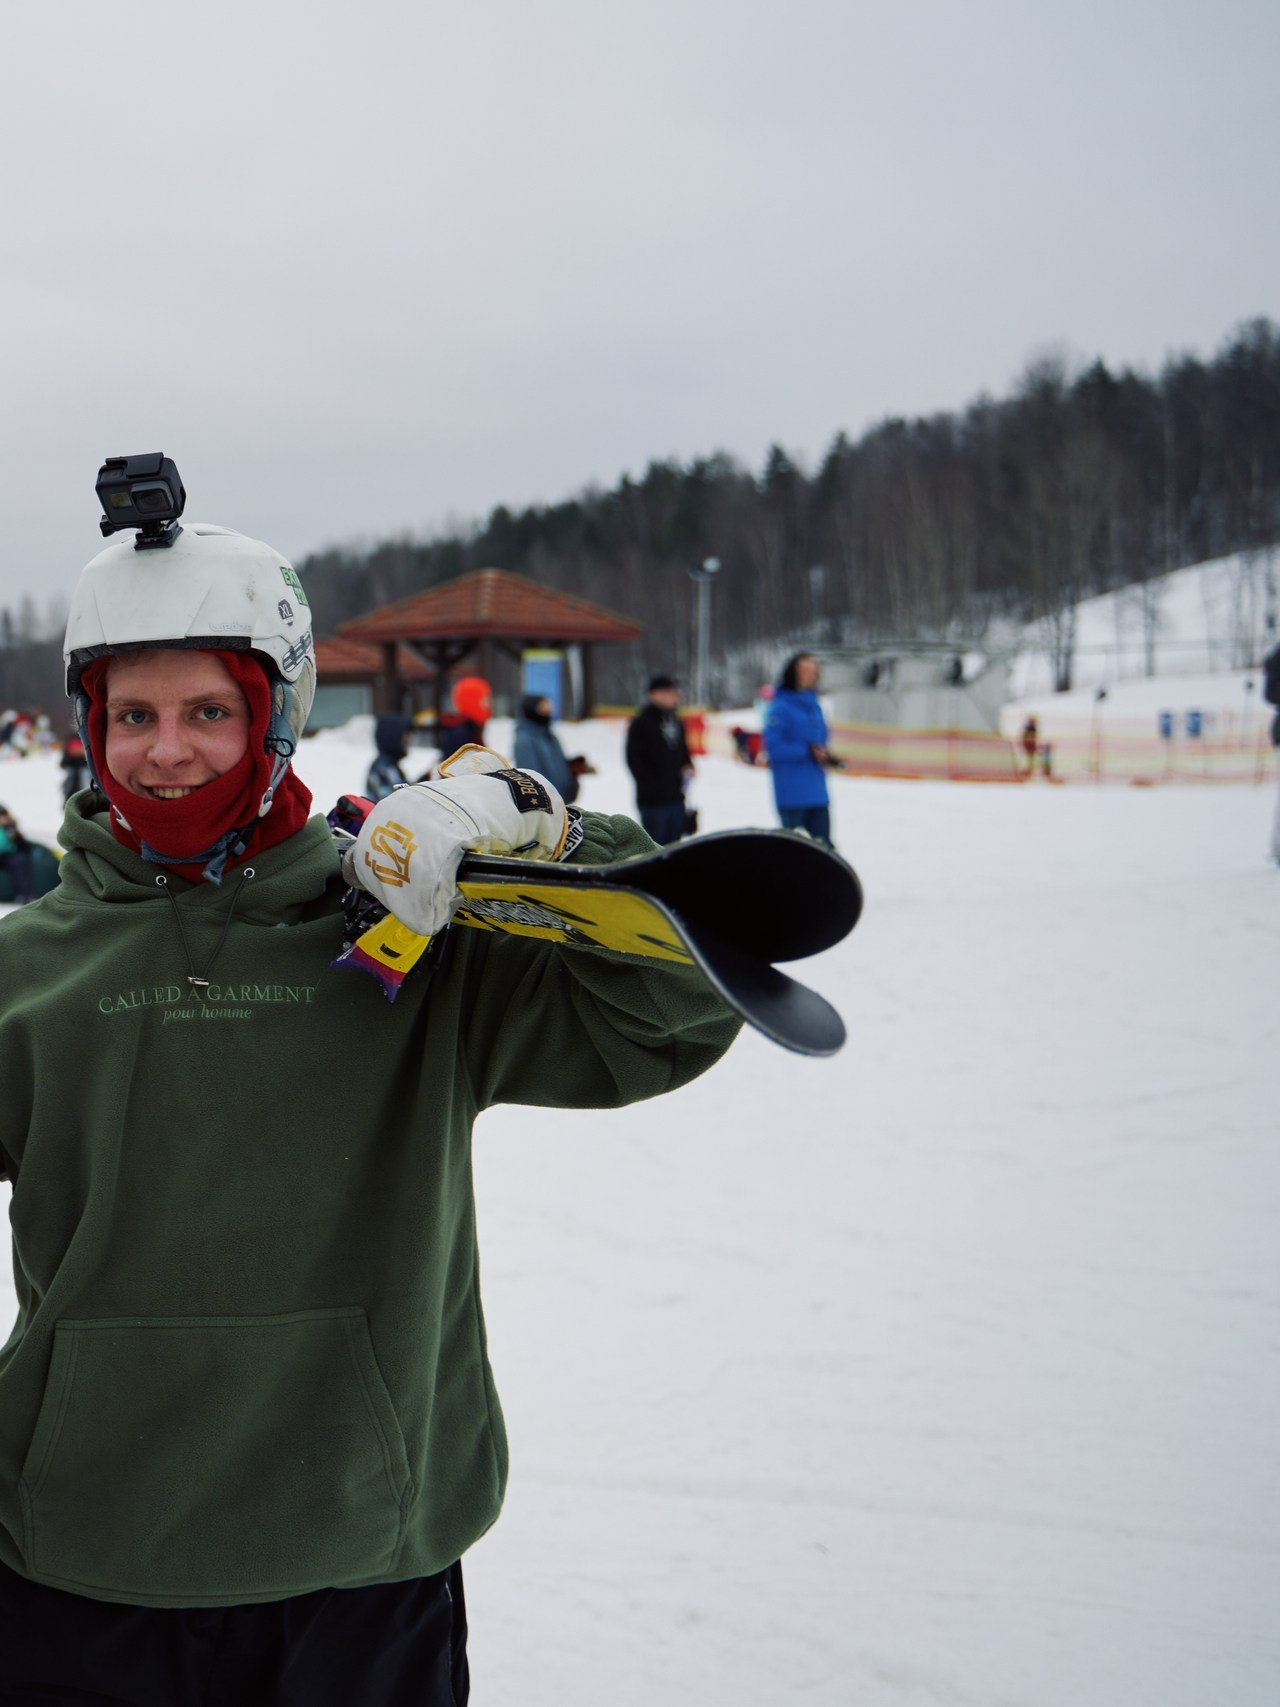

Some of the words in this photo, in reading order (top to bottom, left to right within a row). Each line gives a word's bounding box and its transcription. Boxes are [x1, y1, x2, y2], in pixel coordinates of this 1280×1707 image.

[280, 603, 292, 618] XL
[98, 986, 181, 1014] CALLED
[187, 985, 201, 1001] A
[206, 984, 315, 1003] GARMENT
[162, 1008, 195, 1024] pour
[201, 1004, 252, 1019] homme
